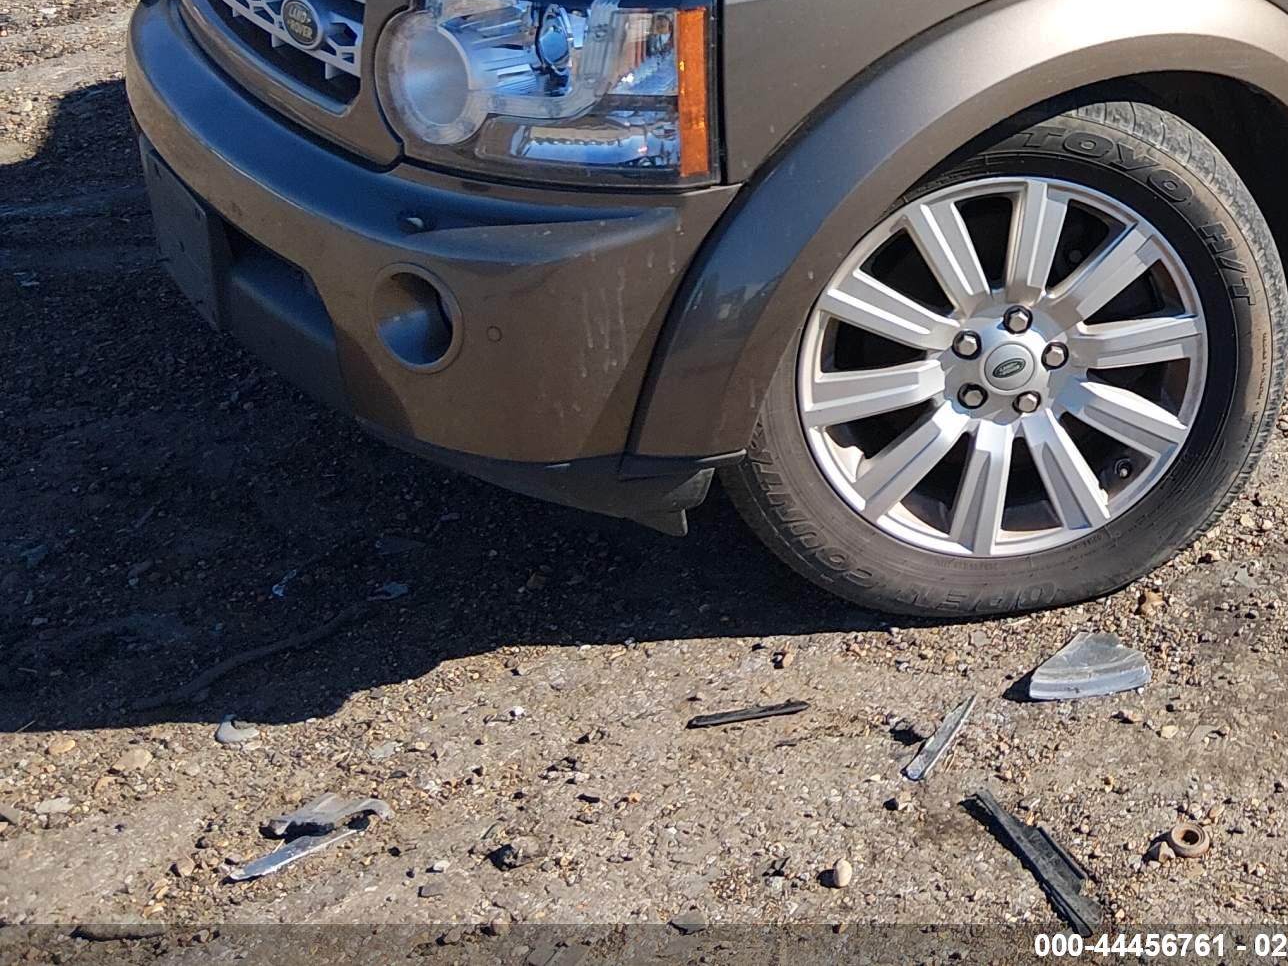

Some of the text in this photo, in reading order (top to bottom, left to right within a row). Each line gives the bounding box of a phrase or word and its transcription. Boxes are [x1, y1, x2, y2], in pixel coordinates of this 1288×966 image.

[287, 18, 313, 40] ROVER
[1015, 127, 1257, 306] TOYO H/T
